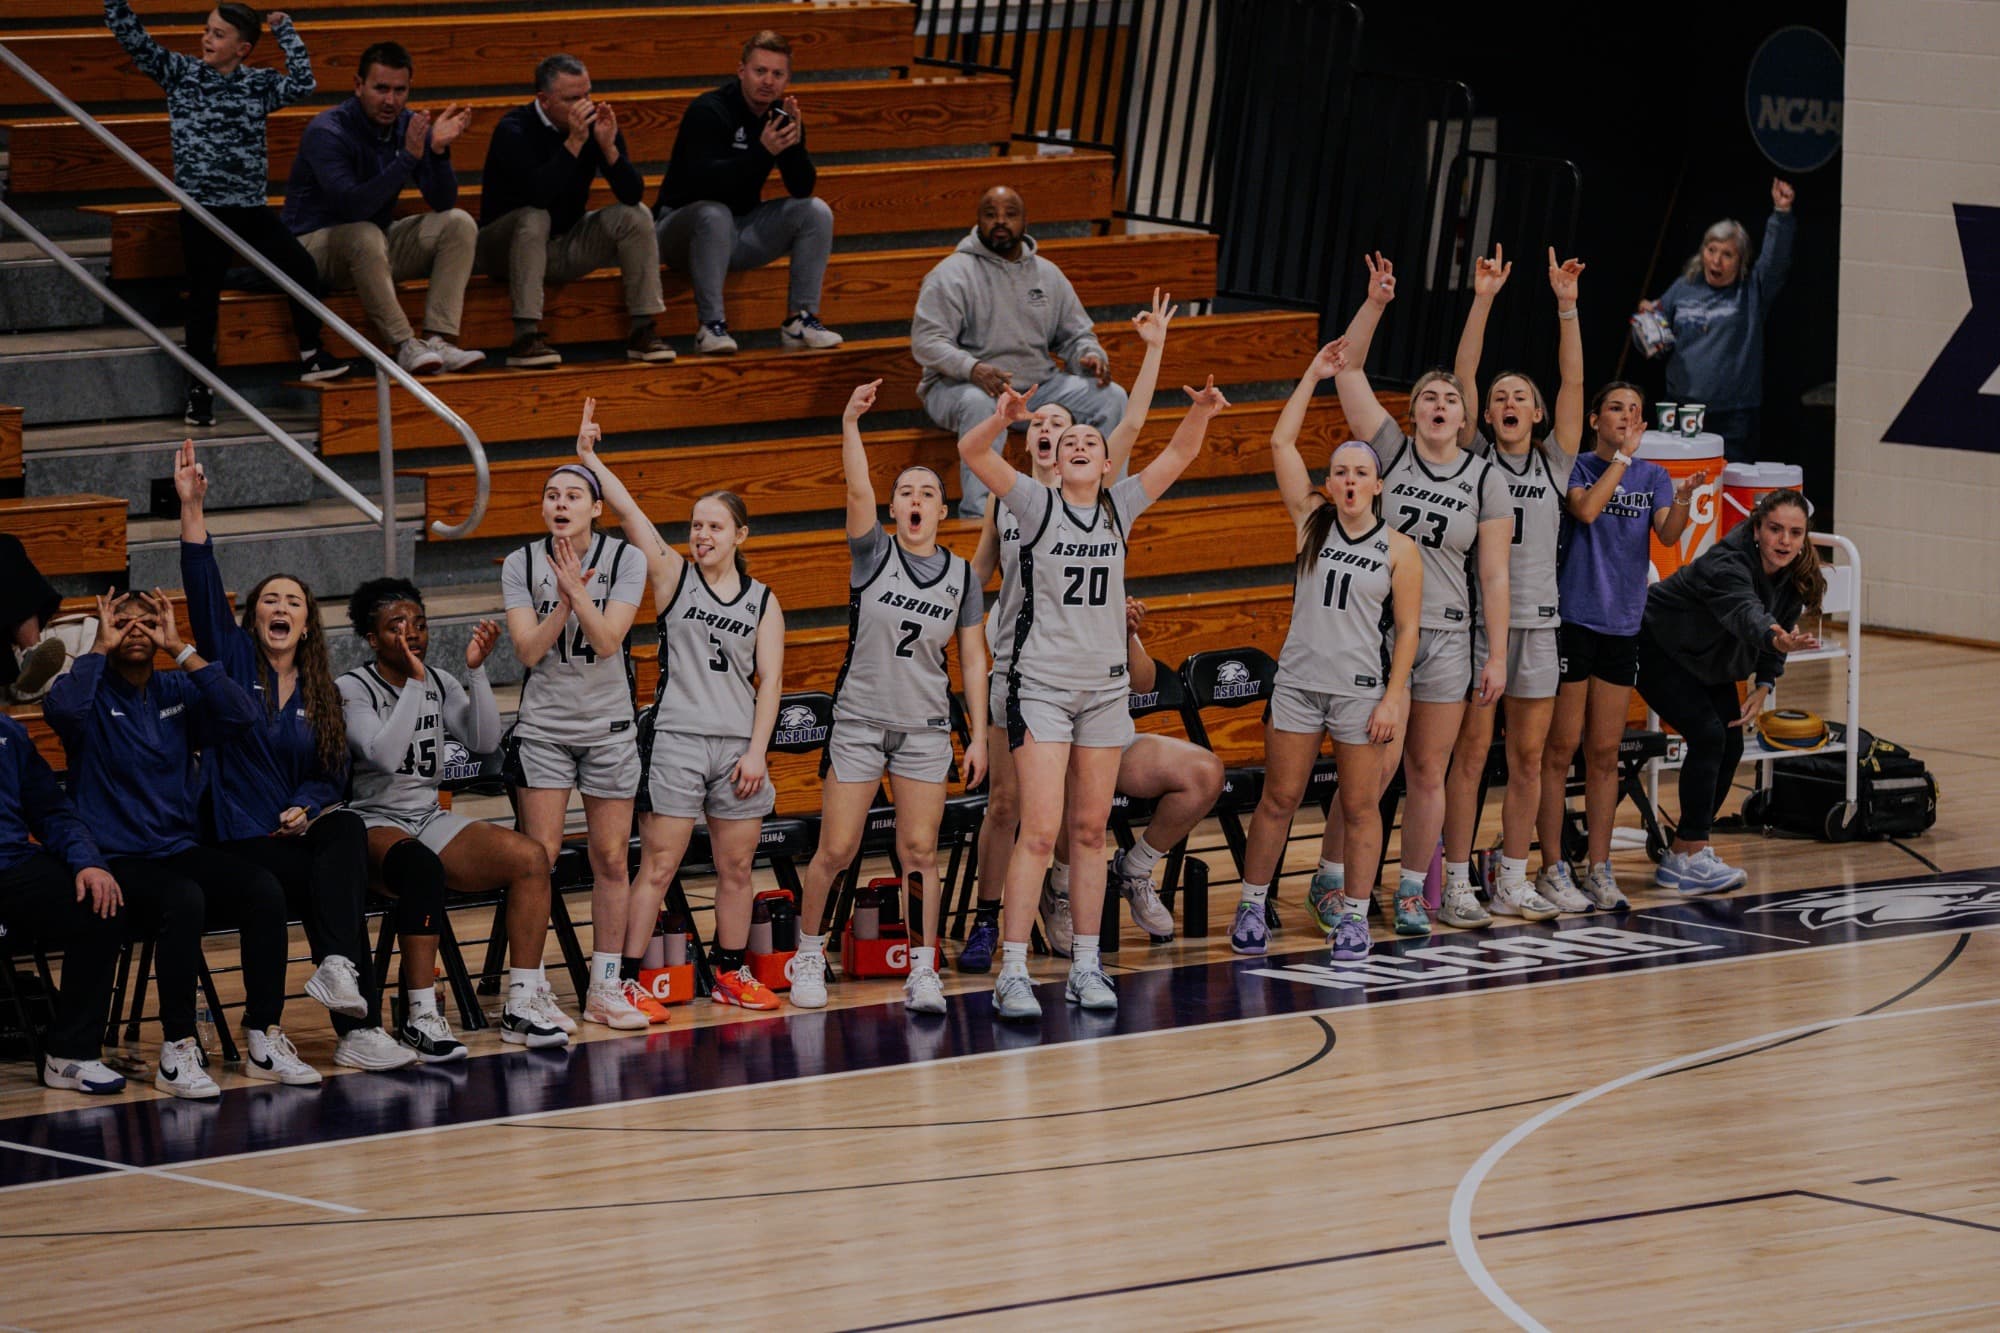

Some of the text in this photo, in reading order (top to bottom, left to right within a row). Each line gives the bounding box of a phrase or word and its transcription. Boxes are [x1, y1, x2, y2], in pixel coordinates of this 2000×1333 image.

[1757, 95, 1843, 134] NCAA
[1662, 410, 1676, 427] G
[1682, 415, 1697, 433] G
[1390, 483, 1469, 513] ASBURY
[1689, 484, 1714, 524] G
[1398, 504, 1449, 549] 23
[1049, 541, 1118, 558] ASBURY
[1319, 546, 1384, 573] SBURY
[1062, 565, 1109, 607] 20
[1323, 568, 1353, 611] 11
[877, 590, 954, 621] ASBURY
[682, 605, 755, 638] ASBURY
[708, 632, 729, 673] 3
[895, 619, 923, 658] 2
[1213, 680, 1260, 700] ASBURY
[776, 725, 828, 744] ASBURY
[443, 761, 482, 780] BURY
[886, 943, 907, 969] G
[653, 973, 670, 999] G
